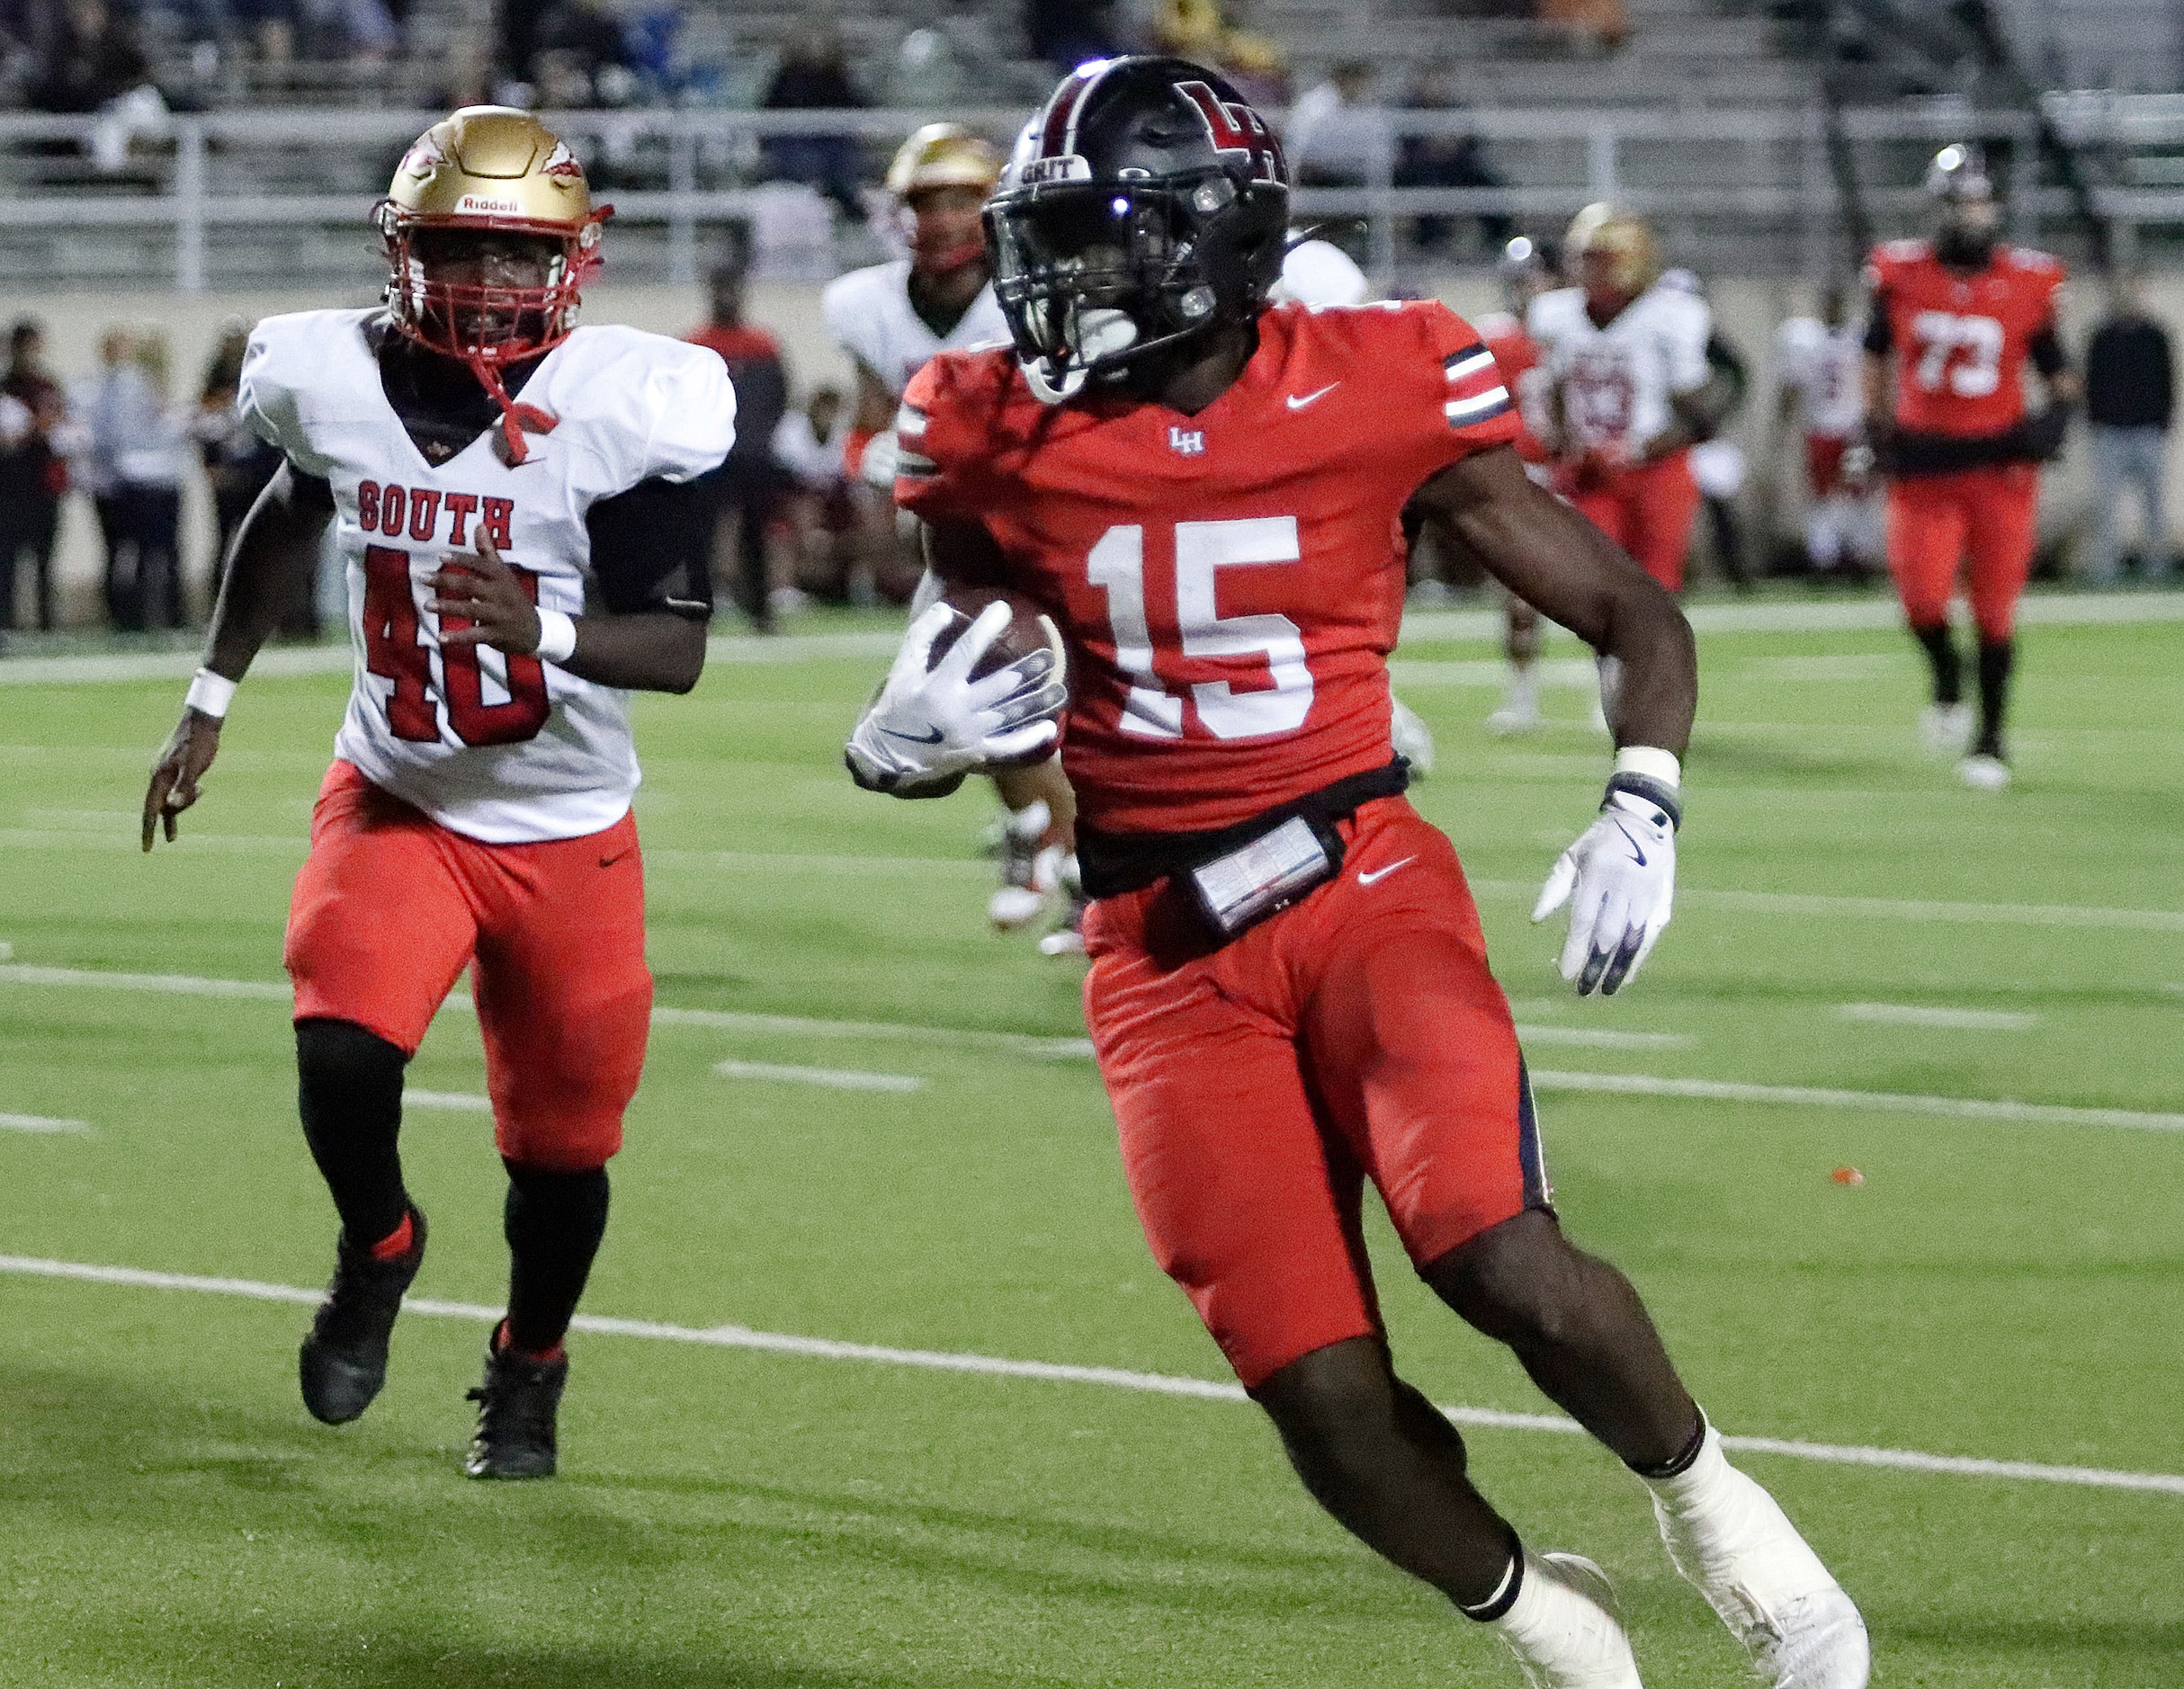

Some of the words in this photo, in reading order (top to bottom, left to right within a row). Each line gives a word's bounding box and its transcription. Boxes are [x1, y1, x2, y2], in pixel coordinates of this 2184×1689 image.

[463, 197, 518, 212] Riddell
[1022, 157, 1075, 183] GRIT
[1913, 309, 2005, 398] 73
[1168, 425, 1204, 455] LH
[359, 479, 514, 551] SOUTH
[363, 542, 551, 747] 40
[1087, 515, 1315, 739] 15
